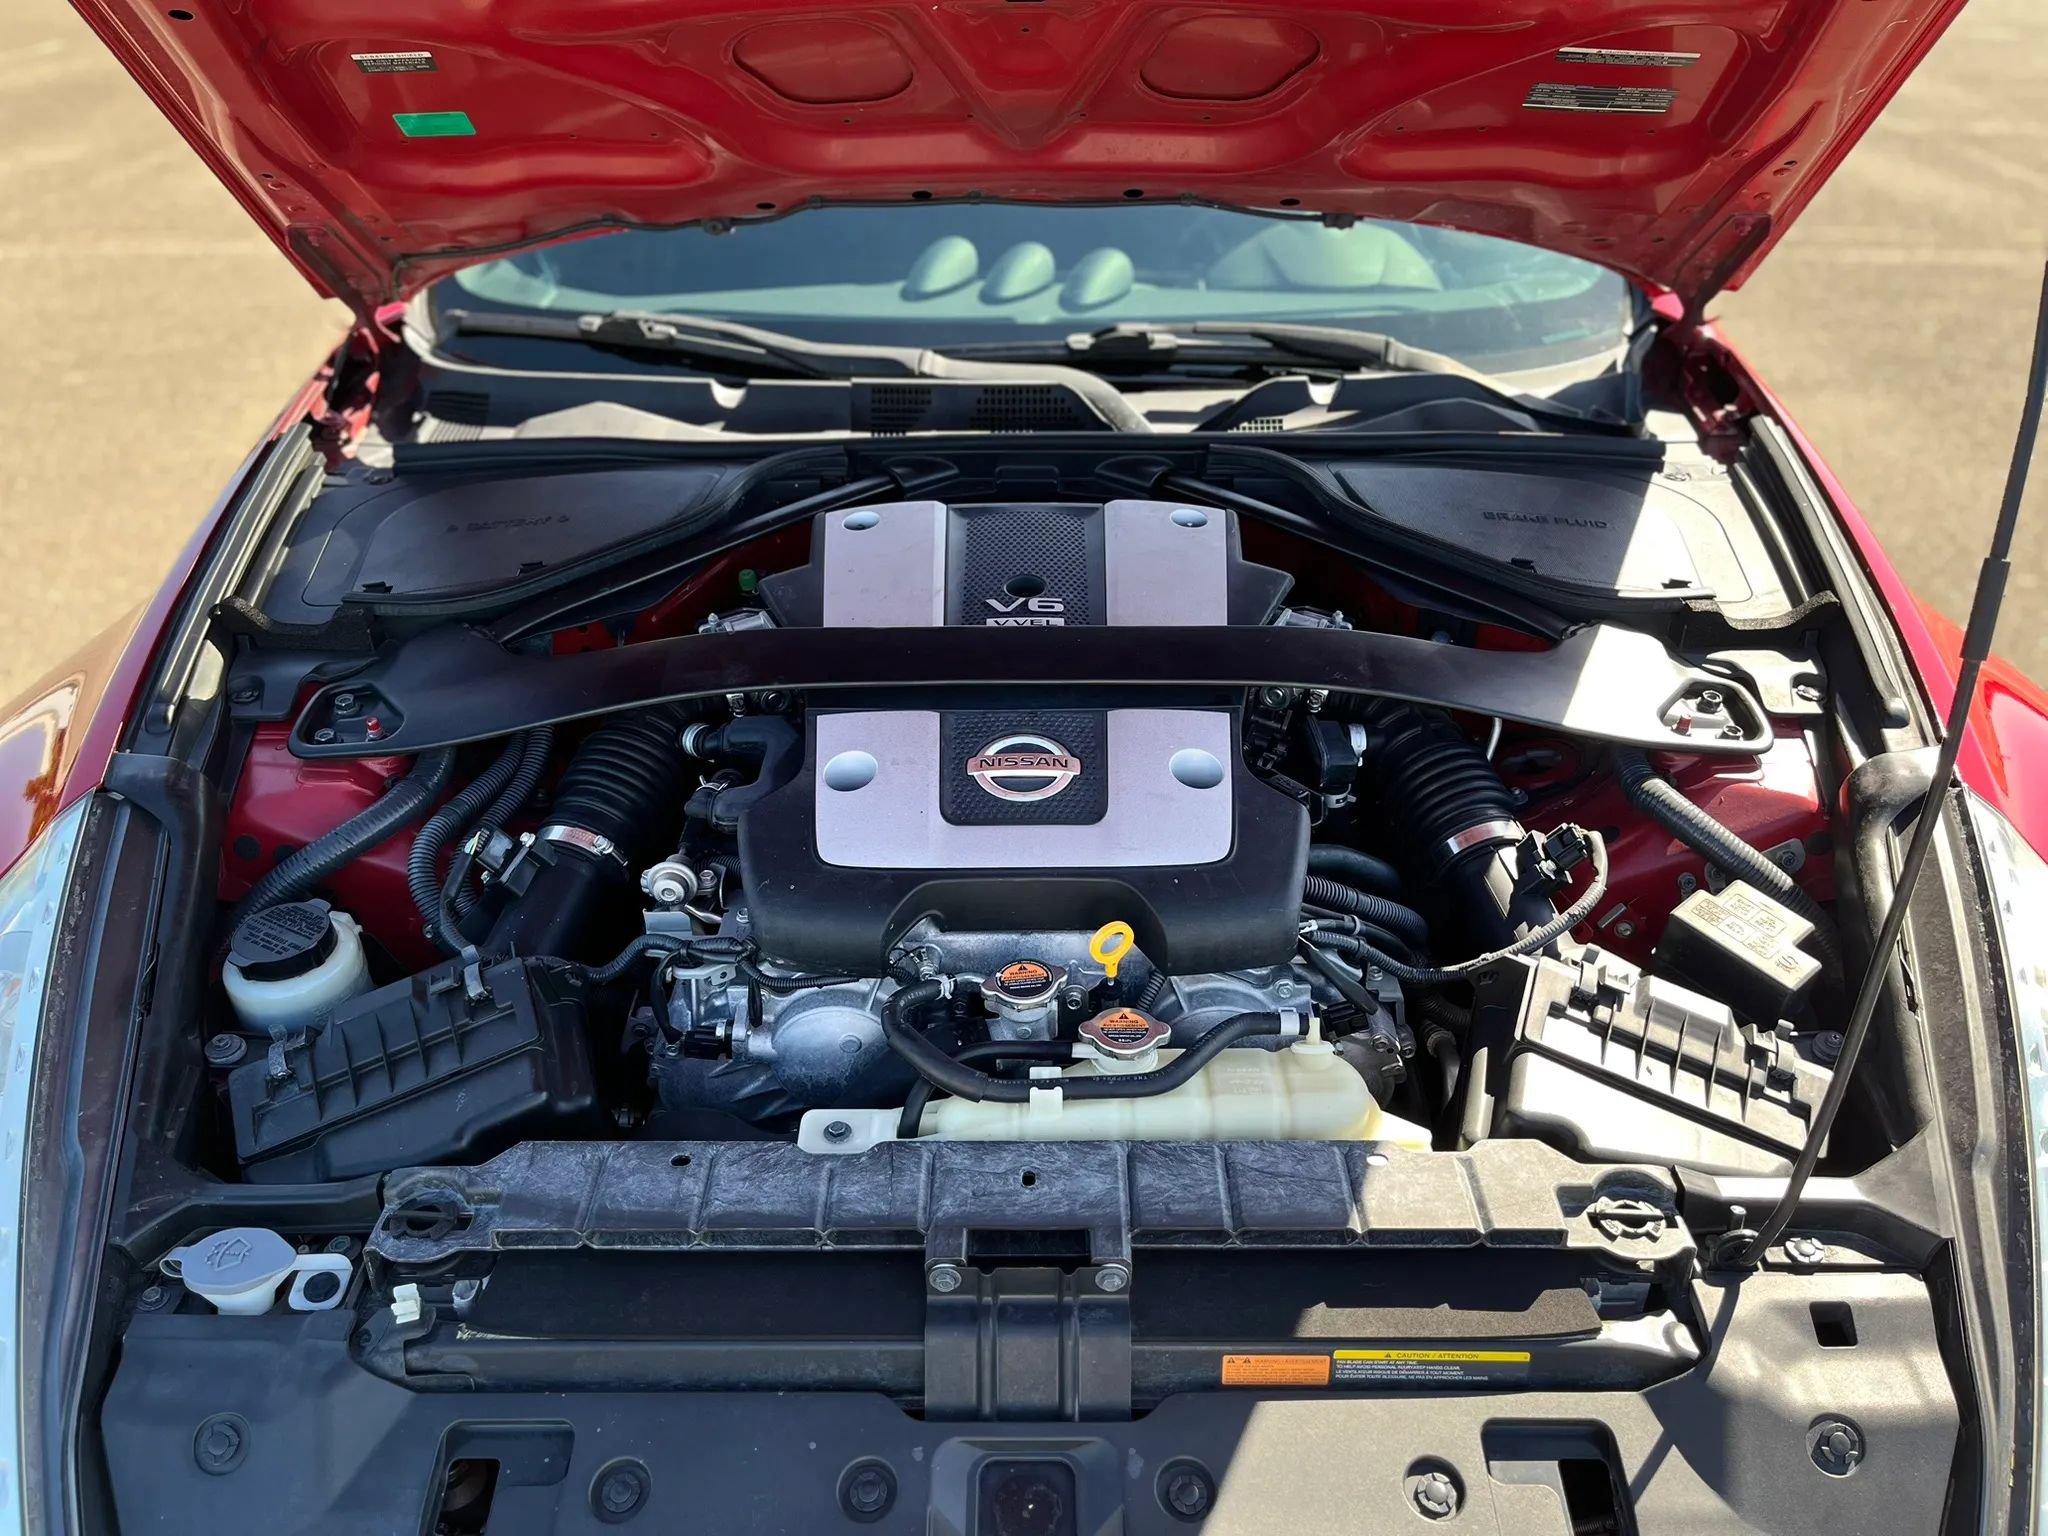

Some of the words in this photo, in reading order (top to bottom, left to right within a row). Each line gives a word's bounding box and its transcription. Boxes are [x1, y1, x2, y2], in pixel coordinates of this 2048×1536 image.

[1482, 511, 1549, 524] BRAKE
[1553, 517, 1608, 528] FLUID
[985, 598, 1064, 612] V6
[979, 757, 1068, 769] NISSAN
